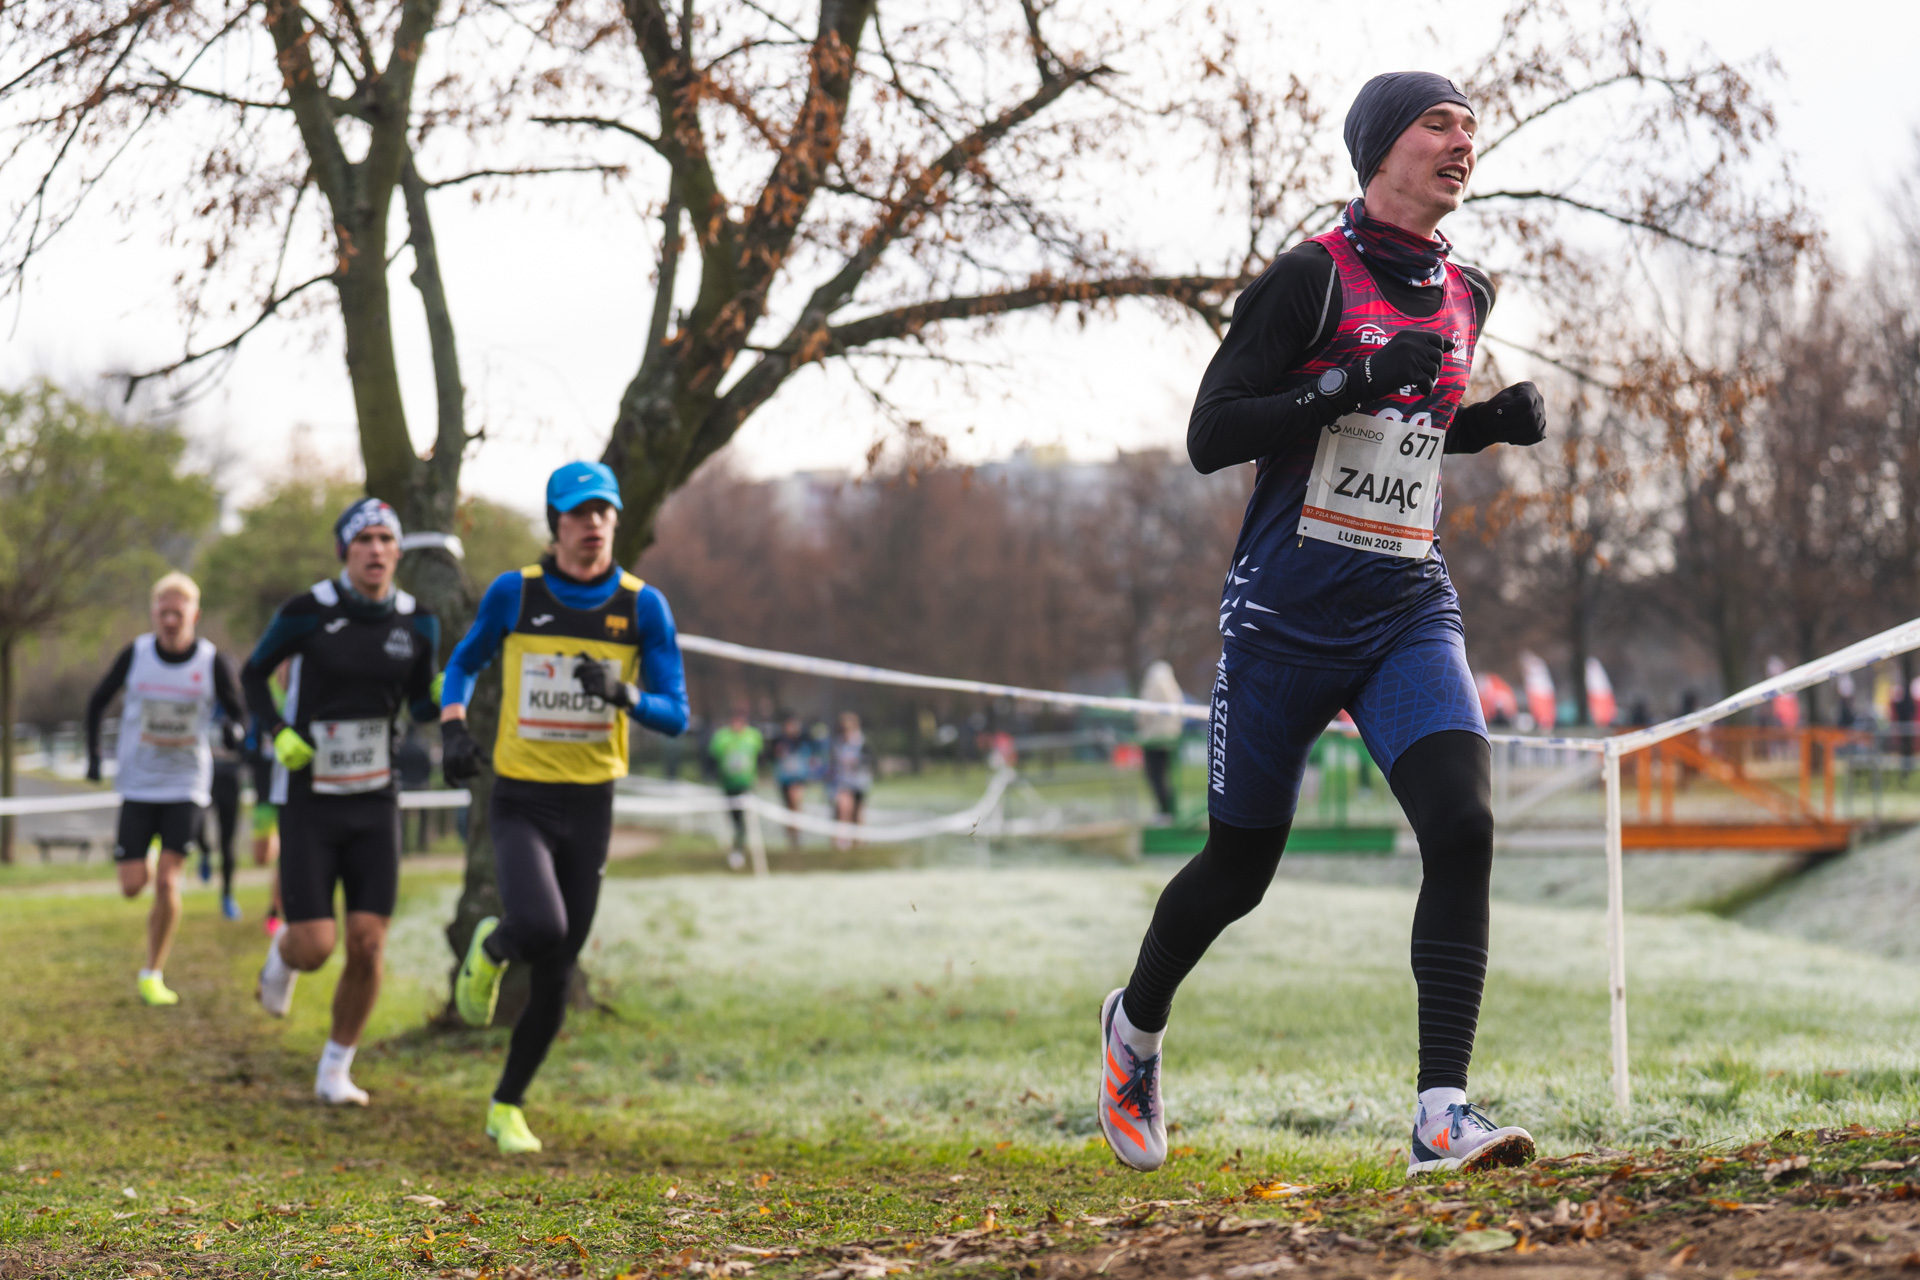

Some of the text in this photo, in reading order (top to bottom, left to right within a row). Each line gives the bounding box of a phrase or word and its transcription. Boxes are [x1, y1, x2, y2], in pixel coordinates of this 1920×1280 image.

[1360, 332, 1391, 346] Ene
[1343, 427, 1384, 442] MUNDO
[1400, 432, 1440, 460] 677
[1334, 467, 1423, 514] ZAJĄC
[1315, 510, 1329, 519] PZLA
[1338, 531, 1402, 552] LUBIN 2025
[1212, 652, 1229, 795] MKL SZCZECIN
